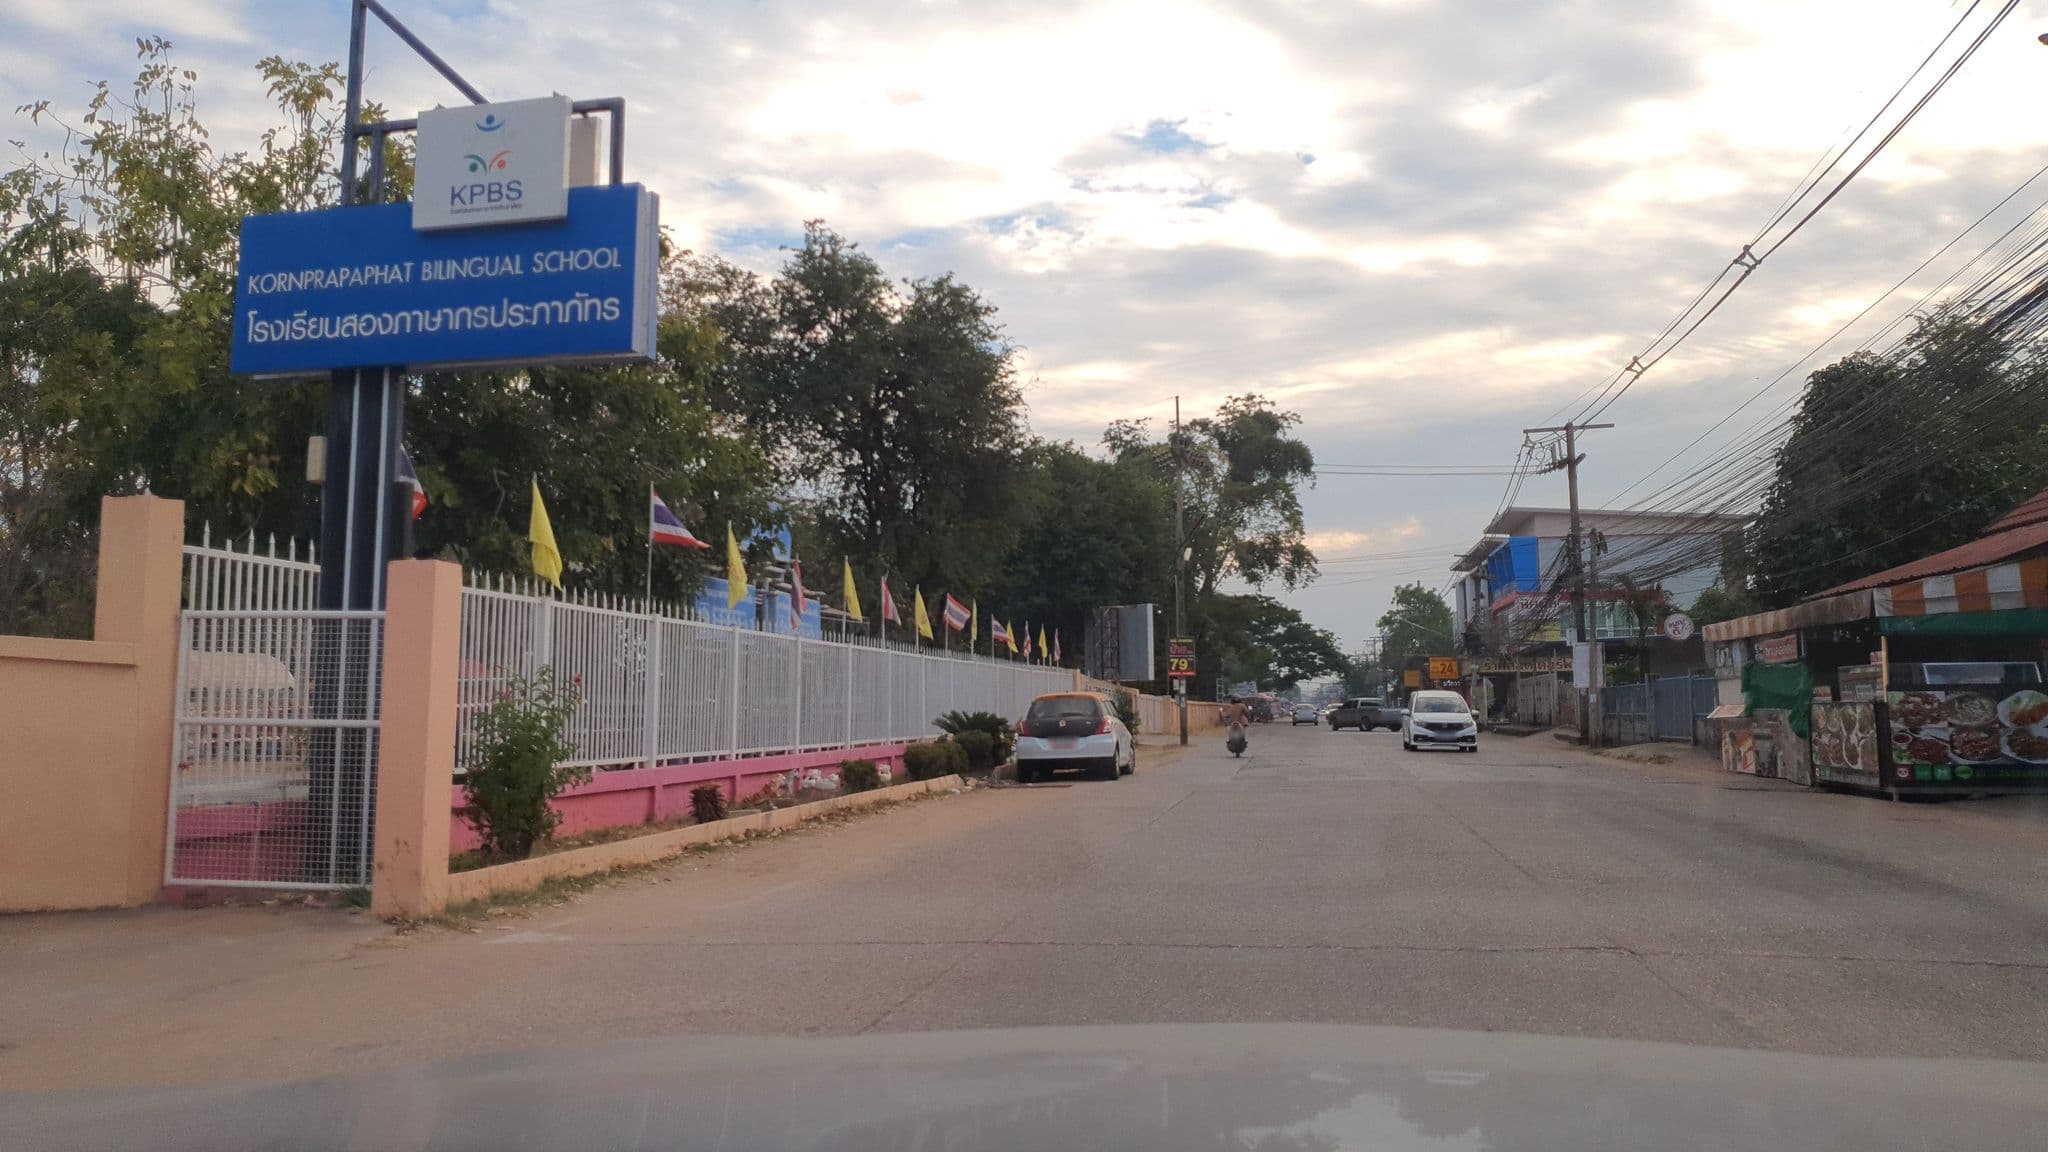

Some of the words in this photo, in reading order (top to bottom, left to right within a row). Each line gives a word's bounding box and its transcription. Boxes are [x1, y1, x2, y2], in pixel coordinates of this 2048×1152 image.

[450, 179, 523, 207] KPBS
[247, 262, 416, 295] KORNPRAPAPHAT
[420, 254, 525, 282] BILINGUAL
[532, 247, 621, 273] SCHOOL
[247, 291, 621, 344] โรงเรียนสองภาษากรประภาภัทร
[1169, 658, 1189, 671] 79
[1439, 662, 1454, 675] 24
